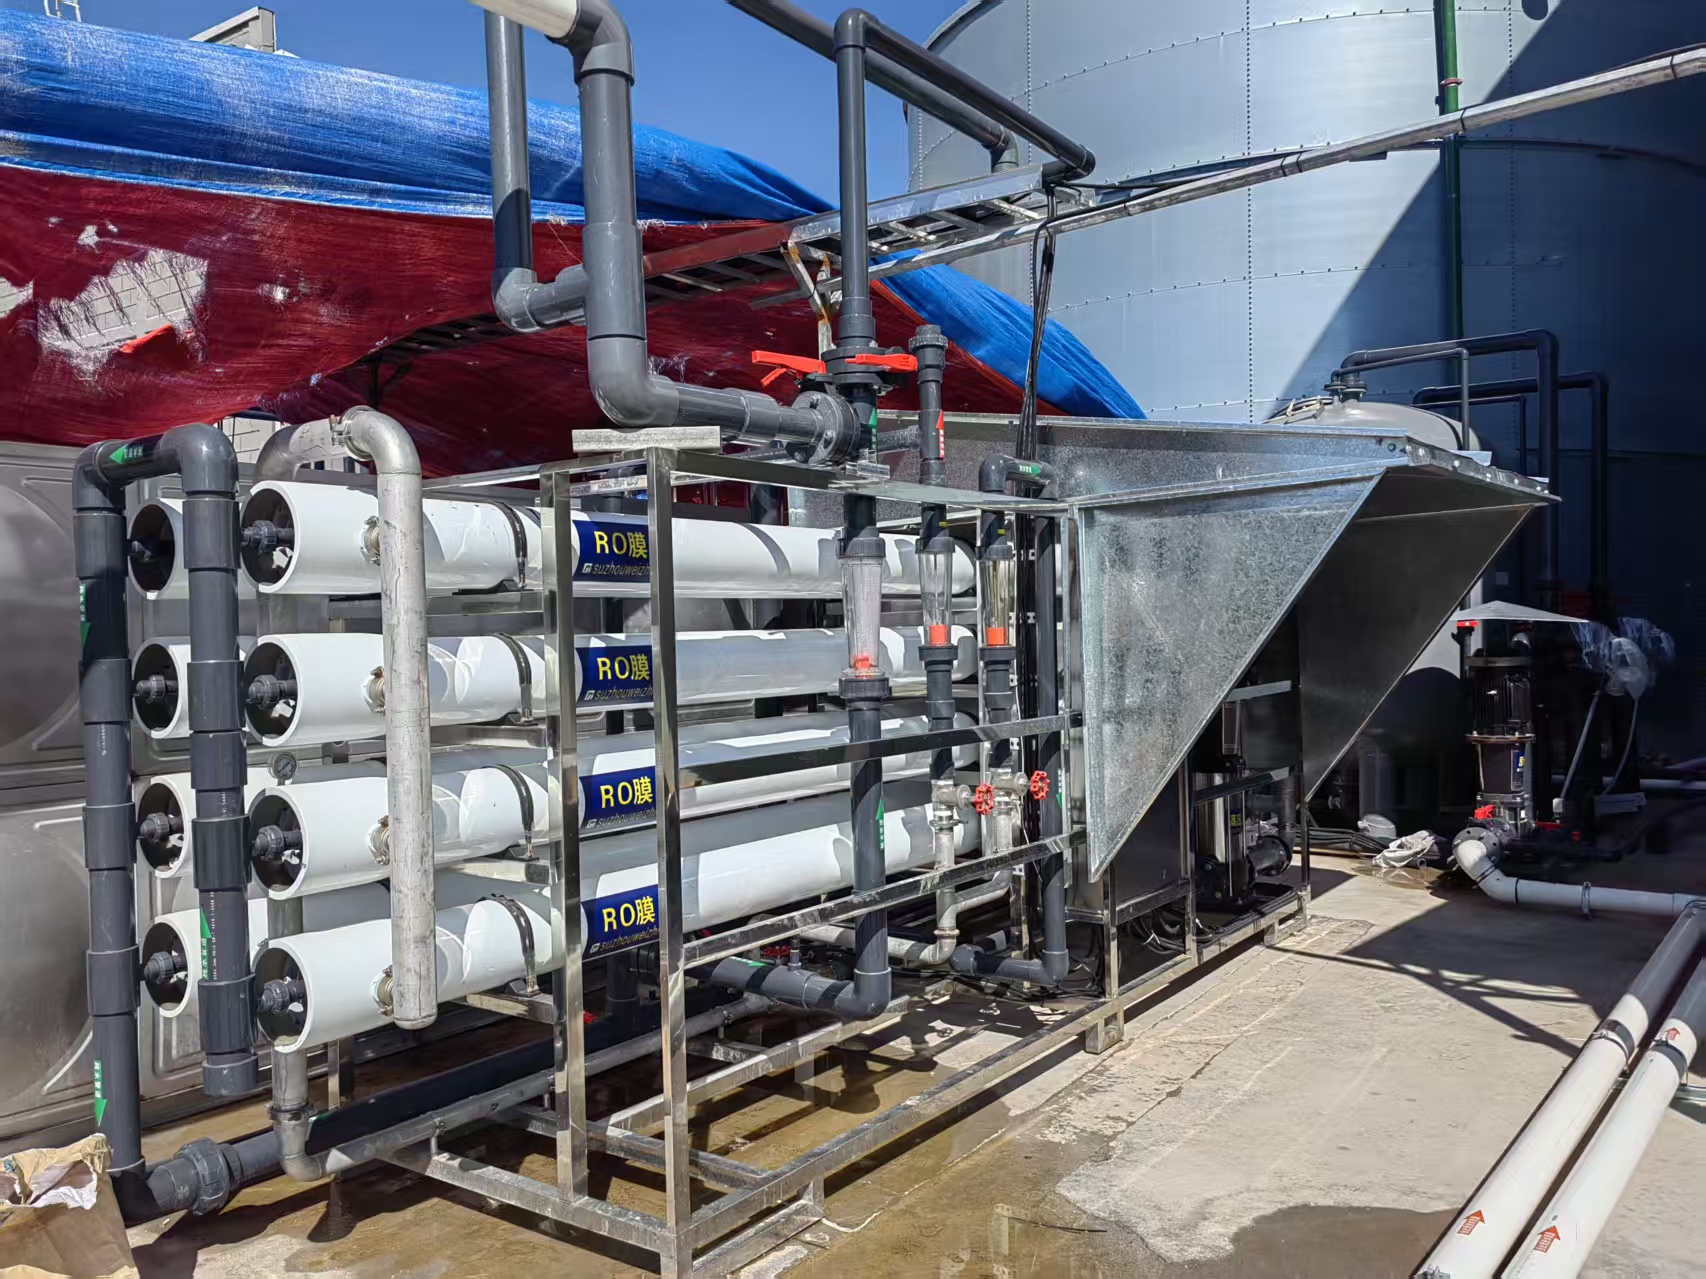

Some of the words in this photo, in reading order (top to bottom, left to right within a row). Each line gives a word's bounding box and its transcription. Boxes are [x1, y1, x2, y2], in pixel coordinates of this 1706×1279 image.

[594, 531, 647, 558] RO膜
[597, 653, 650, 680] RO膜
[595, 685, 653, 701] suzhouweizh
[600, 776, 653, 808] RO膜
[597, 807, 656, 827] suzhouweizh
[602, 896, 655, 932] RO膜
[600, 925, 659, 952] suzhouweizh
